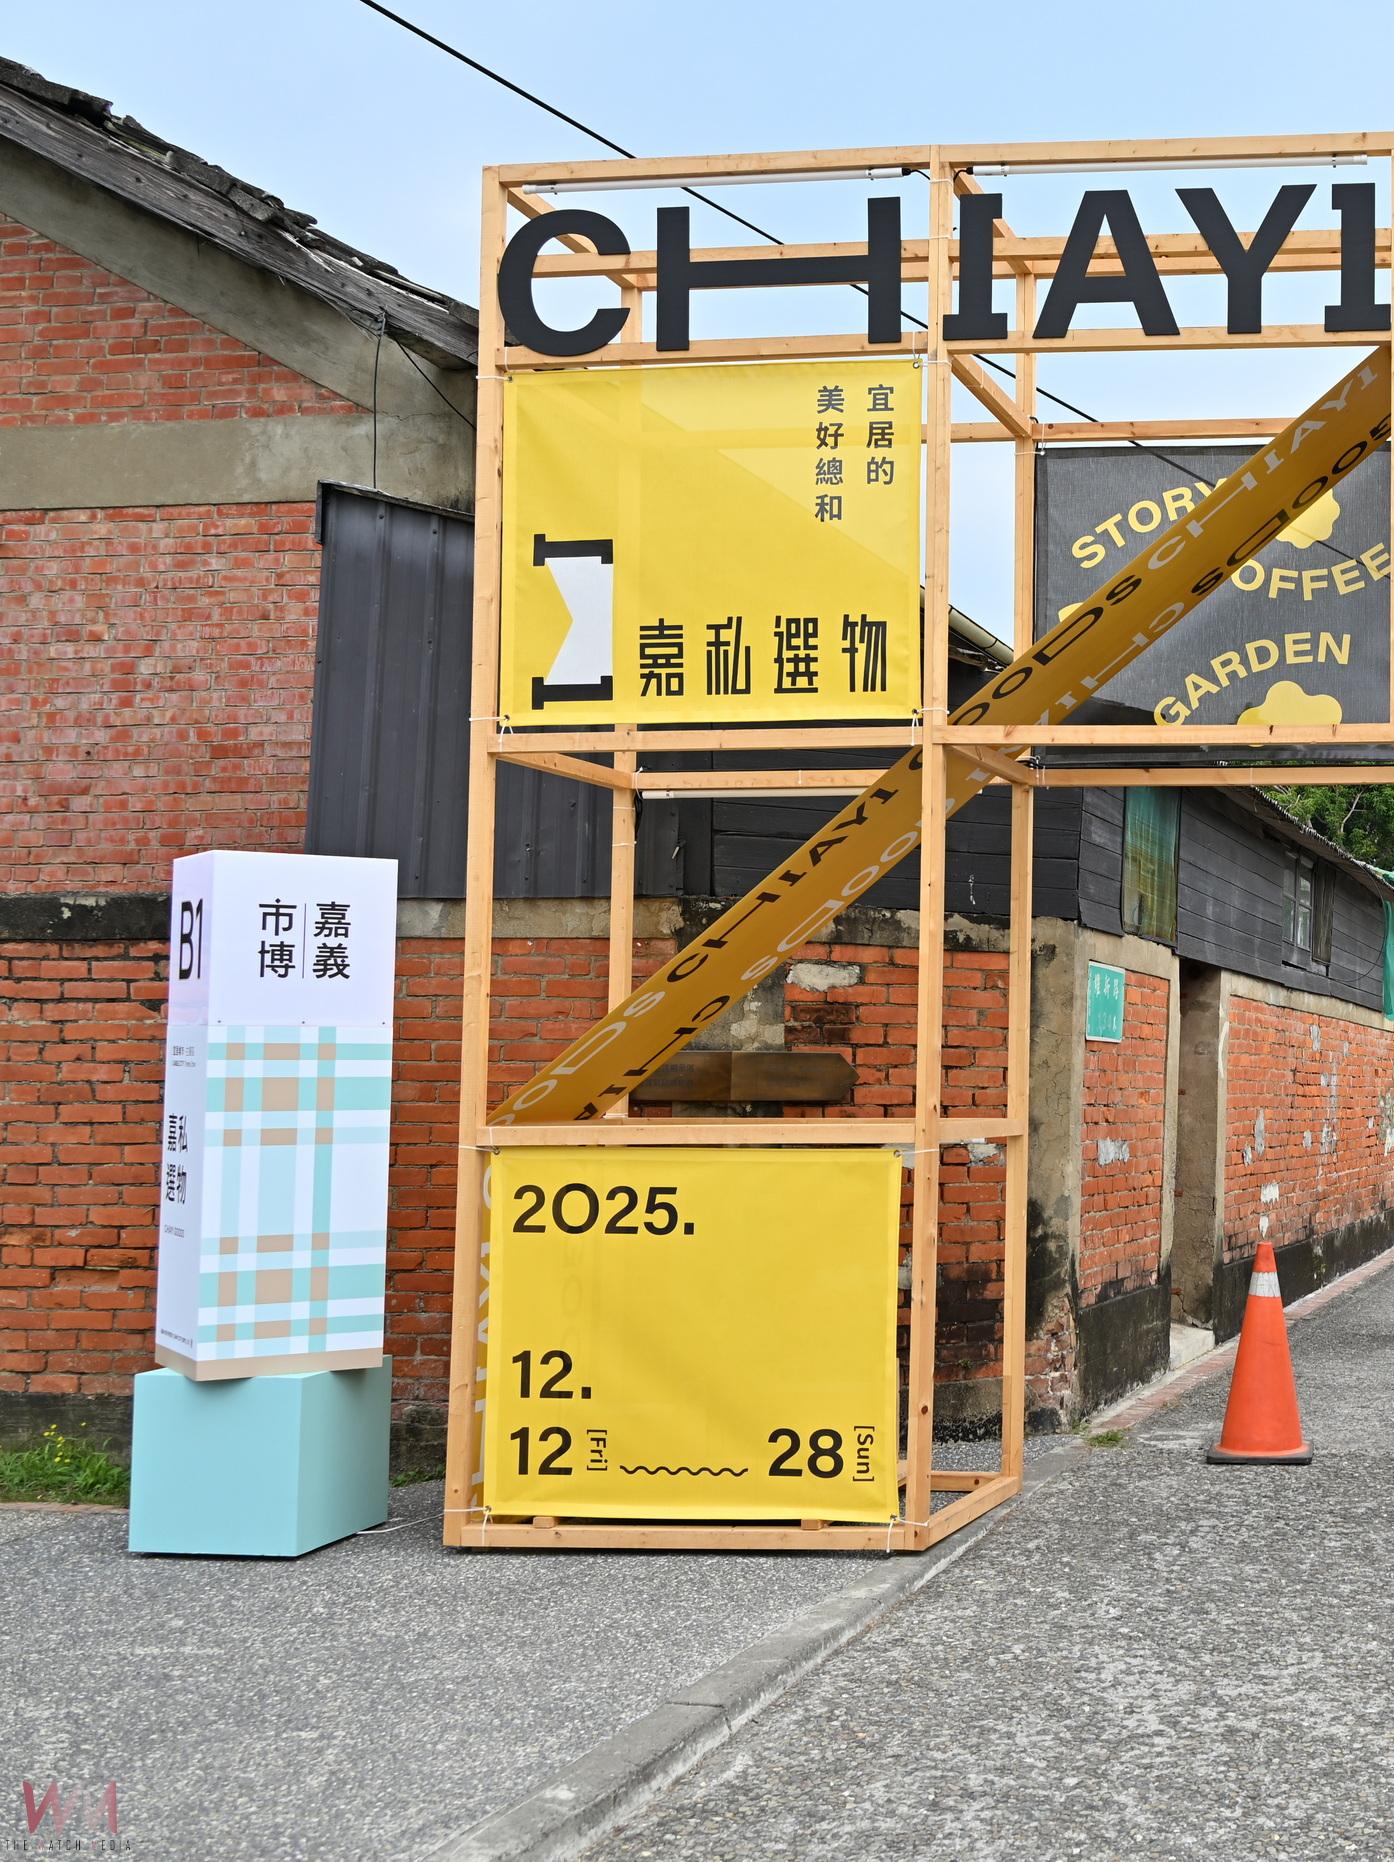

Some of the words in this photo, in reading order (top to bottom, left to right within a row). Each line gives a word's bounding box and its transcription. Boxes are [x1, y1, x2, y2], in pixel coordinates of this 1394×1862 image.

[814, 385, 845, 523] 美好總和
[866, 384, 895, 486] 宜居的
[1230, 543, 1391, 601] OFFEE
[639, 613, 887, 697] 嘉私選物
[1153, 631, 1351, 726] GARDEN
[179, 898, 203, 980] B1
[257, 897, 298, 979] 市博
[312, 900, 351, 980] 嘉義
[512, 1182, 696, 1236] 2025.
[512, 1349, 592, 1400] 12.
[510, 1426, 573, 1477] 12
[768, 1428, 844, 1478] 28
